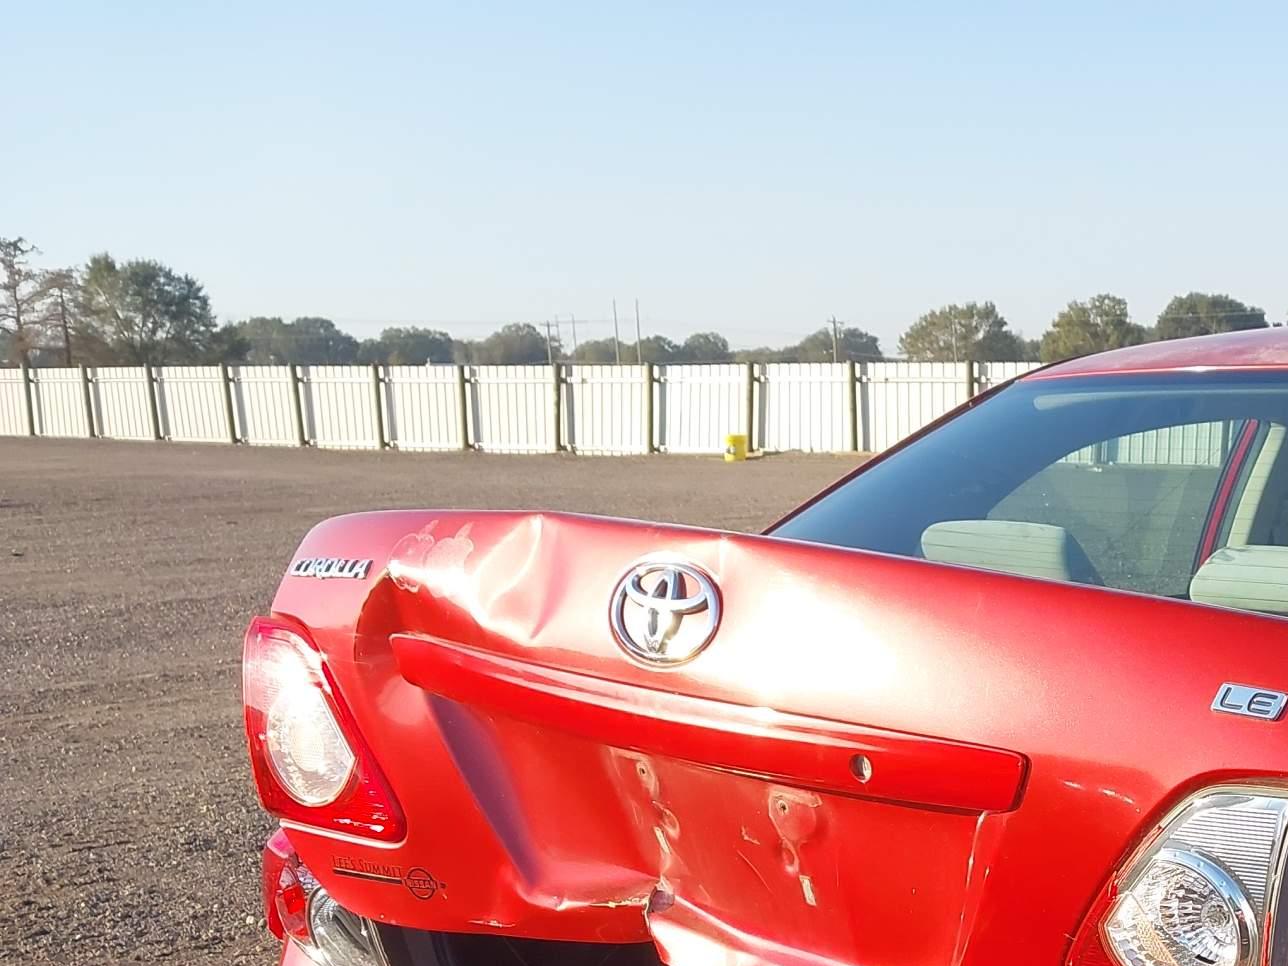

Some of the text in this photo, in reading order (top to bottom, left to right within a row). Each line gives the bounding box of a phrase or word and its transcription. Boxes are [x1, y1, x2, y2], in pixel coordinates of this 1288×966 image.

[290, 558, 371, 580] COROLLA
[1217, 685, 1282, 717] LE
[358, 859, 402, 878] SUMMIT
